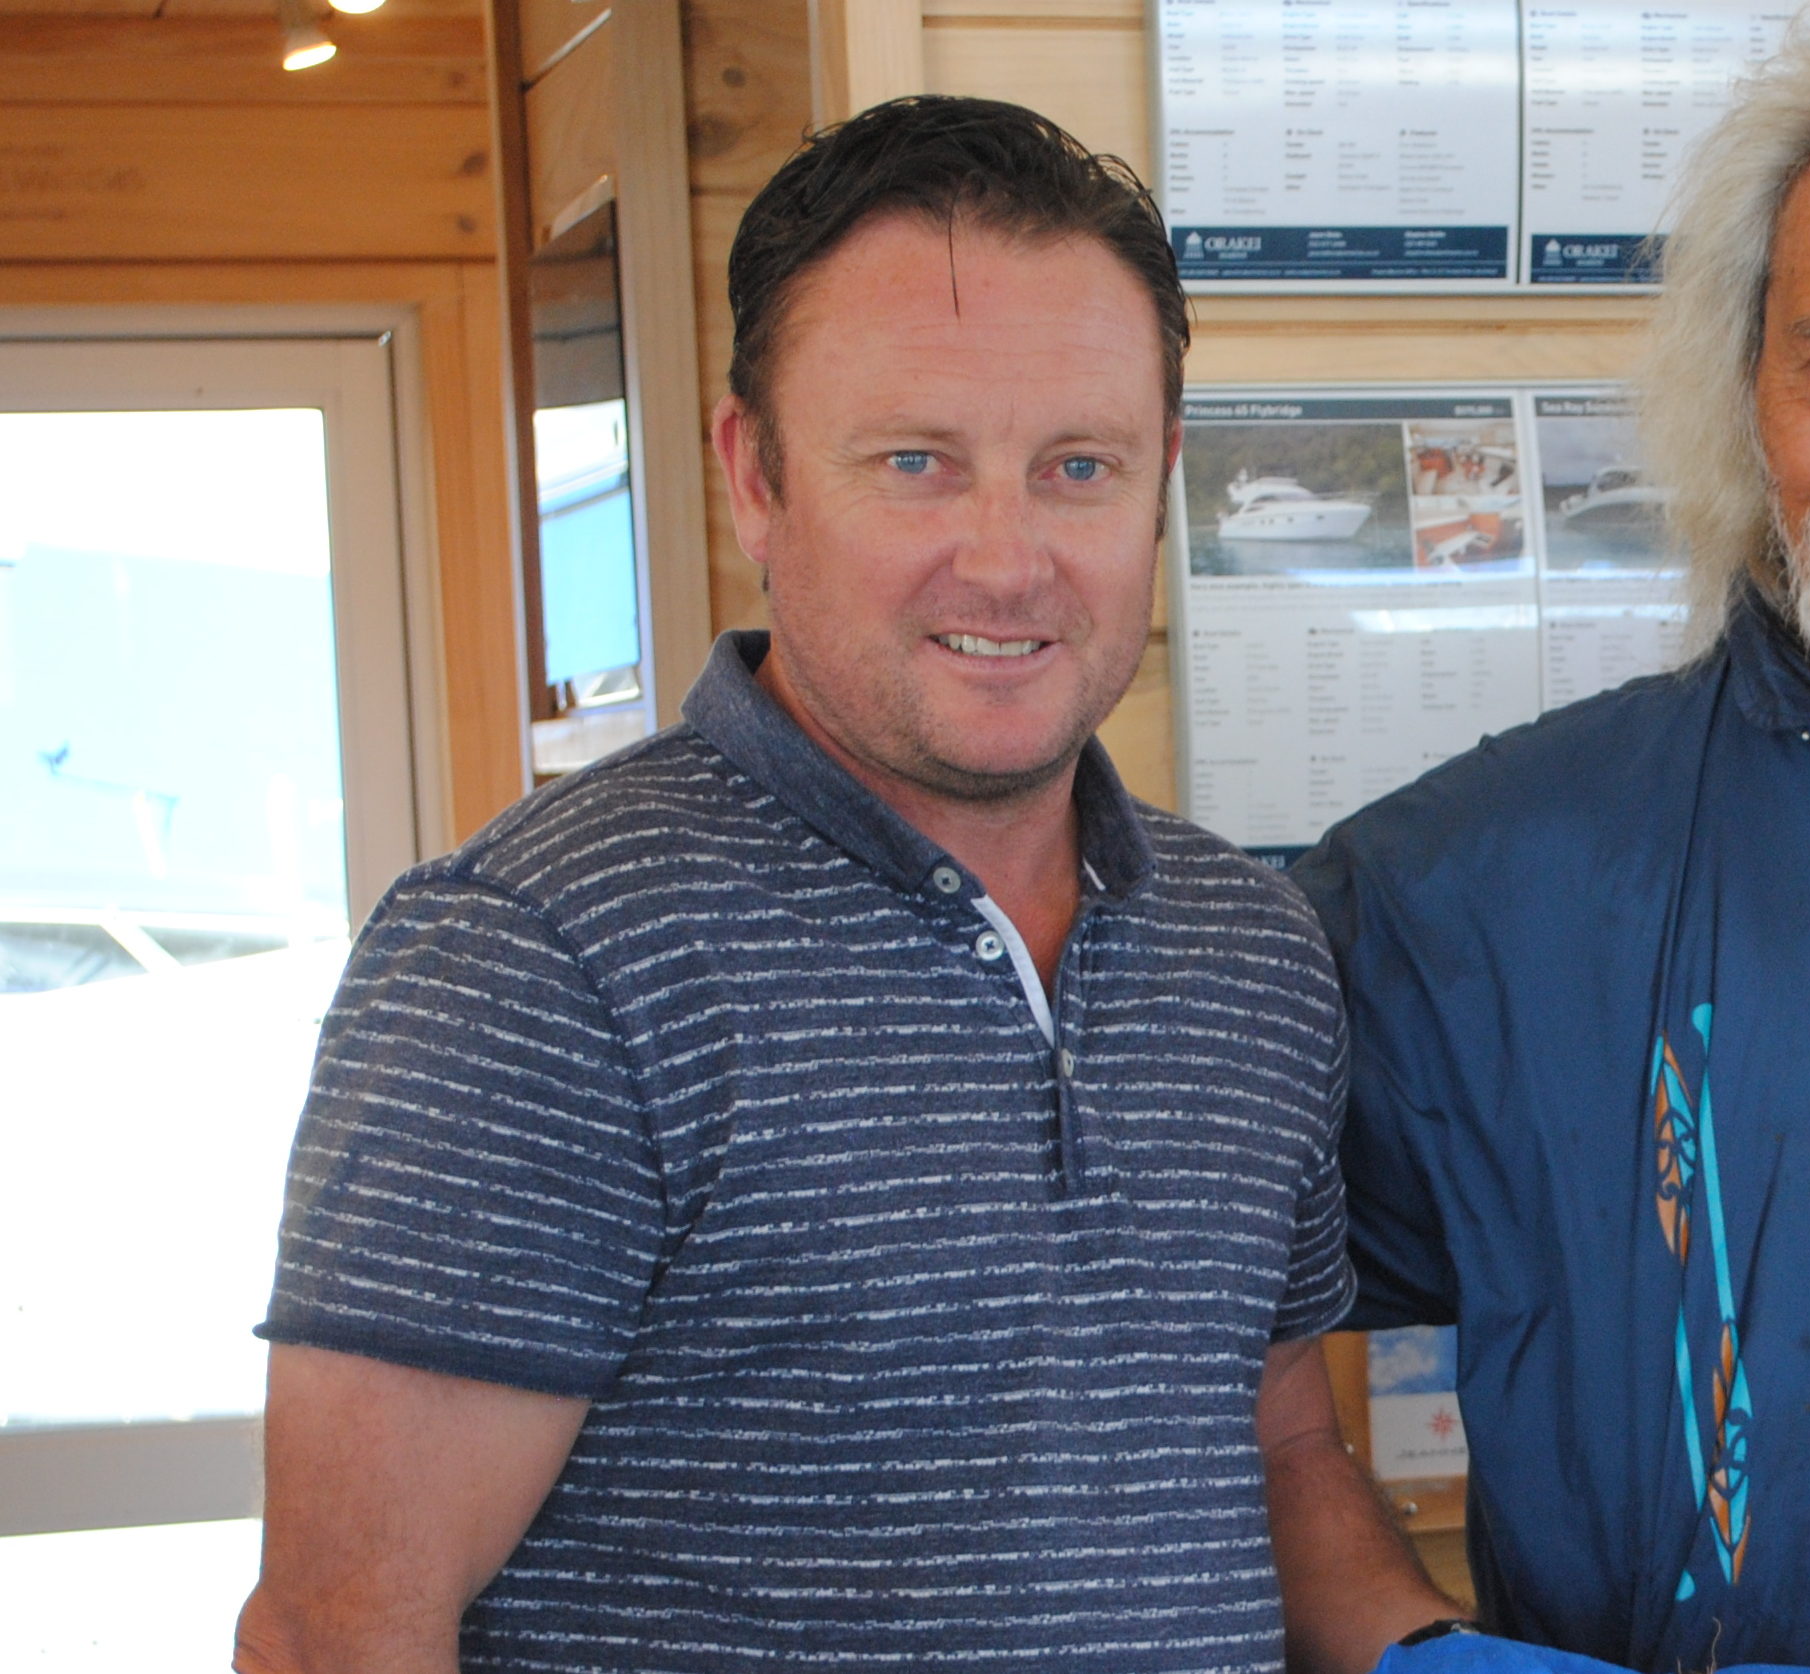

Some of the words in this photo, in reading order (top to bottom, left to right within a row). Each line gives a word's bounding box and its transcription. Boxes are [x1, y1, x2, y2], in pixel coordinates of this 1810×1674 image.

[1204, 235, 1262, 251] ORAKEI
[1562, 243, 1618, 259] ORAKEI
[1184, 404, 1233, 418] Princess
[1250, 403, 1303, 419] Flybridge
